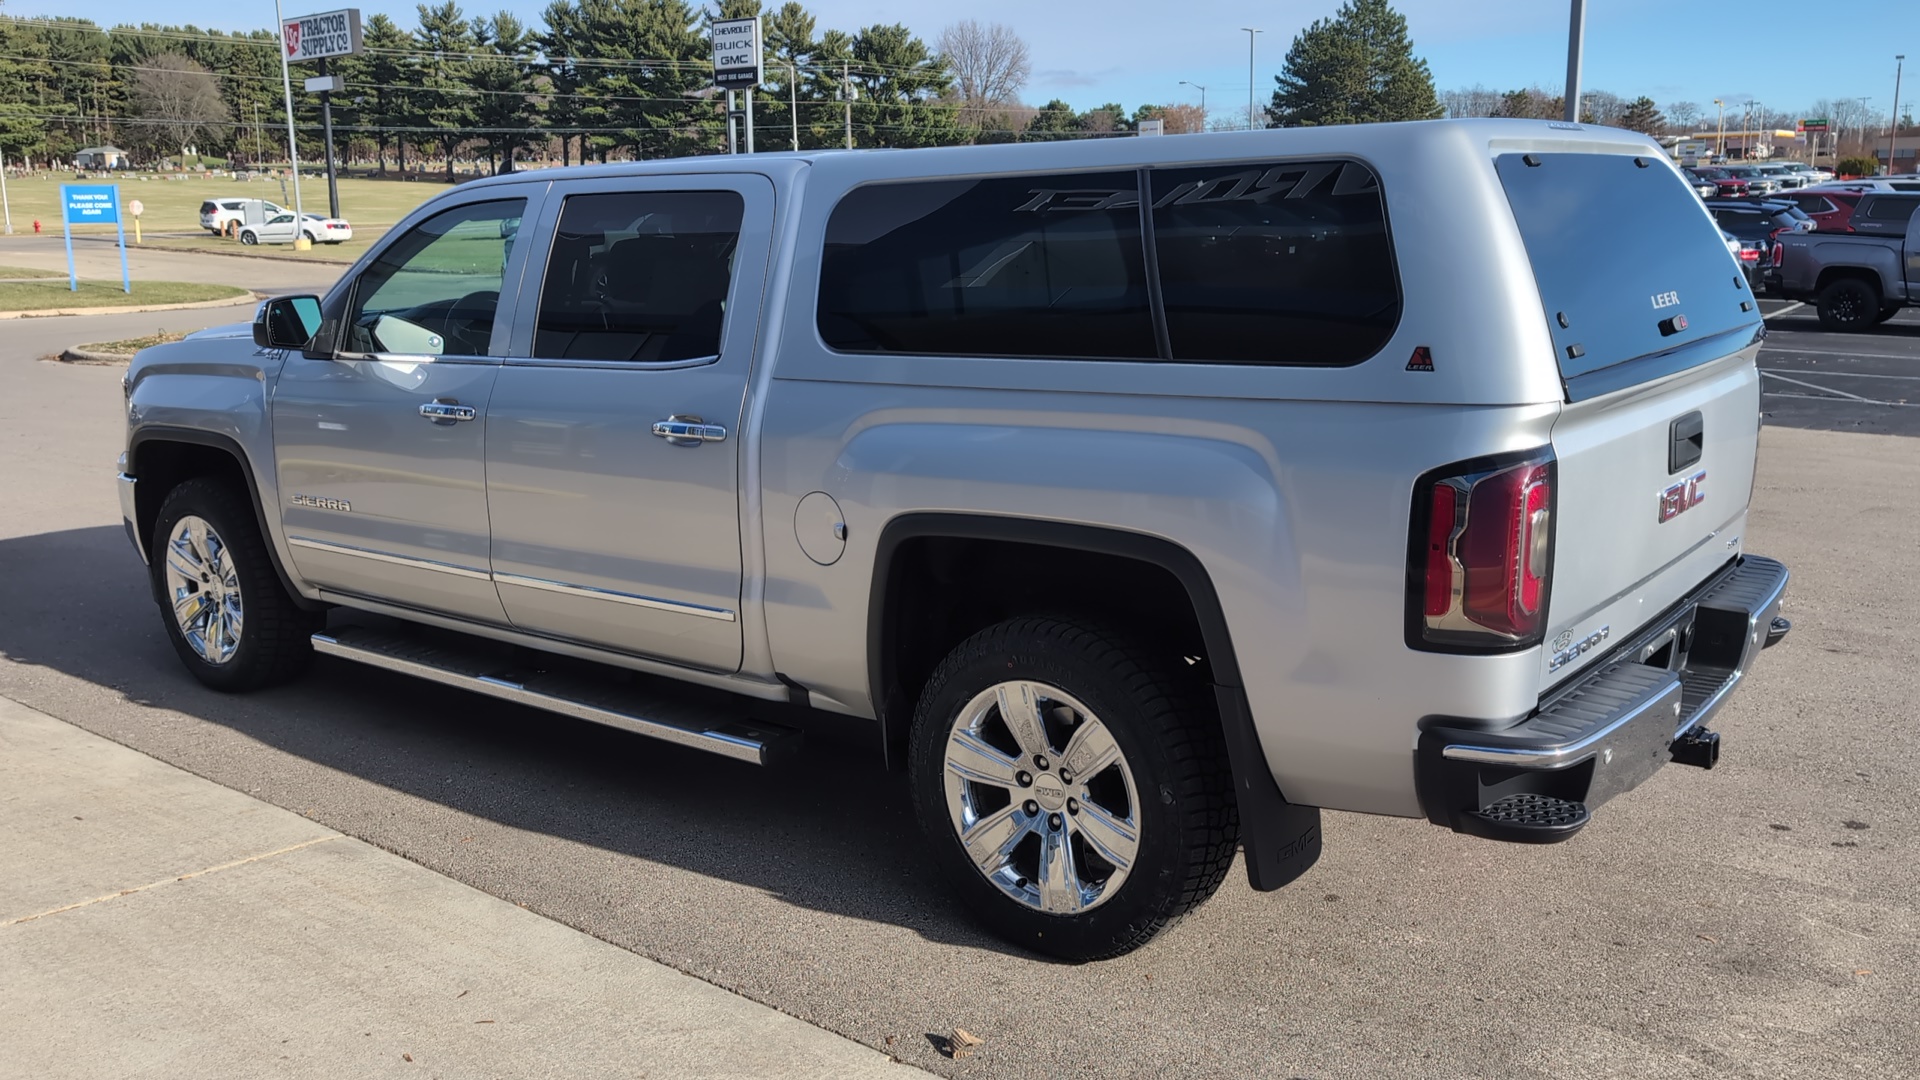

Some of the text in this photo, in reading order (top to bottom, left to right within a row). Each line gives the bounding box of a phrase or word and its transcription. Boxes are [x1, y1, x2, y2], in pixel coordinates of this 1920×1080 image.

[300, 14, 346, 37] TRACTOR
[715, 25, 752, 36] CHEVROLET
[302, 34, 335, 56] SUPPLY
[715, 40, 752, 50] BUICK
[720, 54, 748, 66] GMC
[1650, 290, 1680, 309] LEER
[291, 493, 352, 512] SIERRA
[1657, 469, 1706, 524] GMC
[1549, 624, 1610, 675] SIERRA
[1276, 825, 1314, 864] GMC
